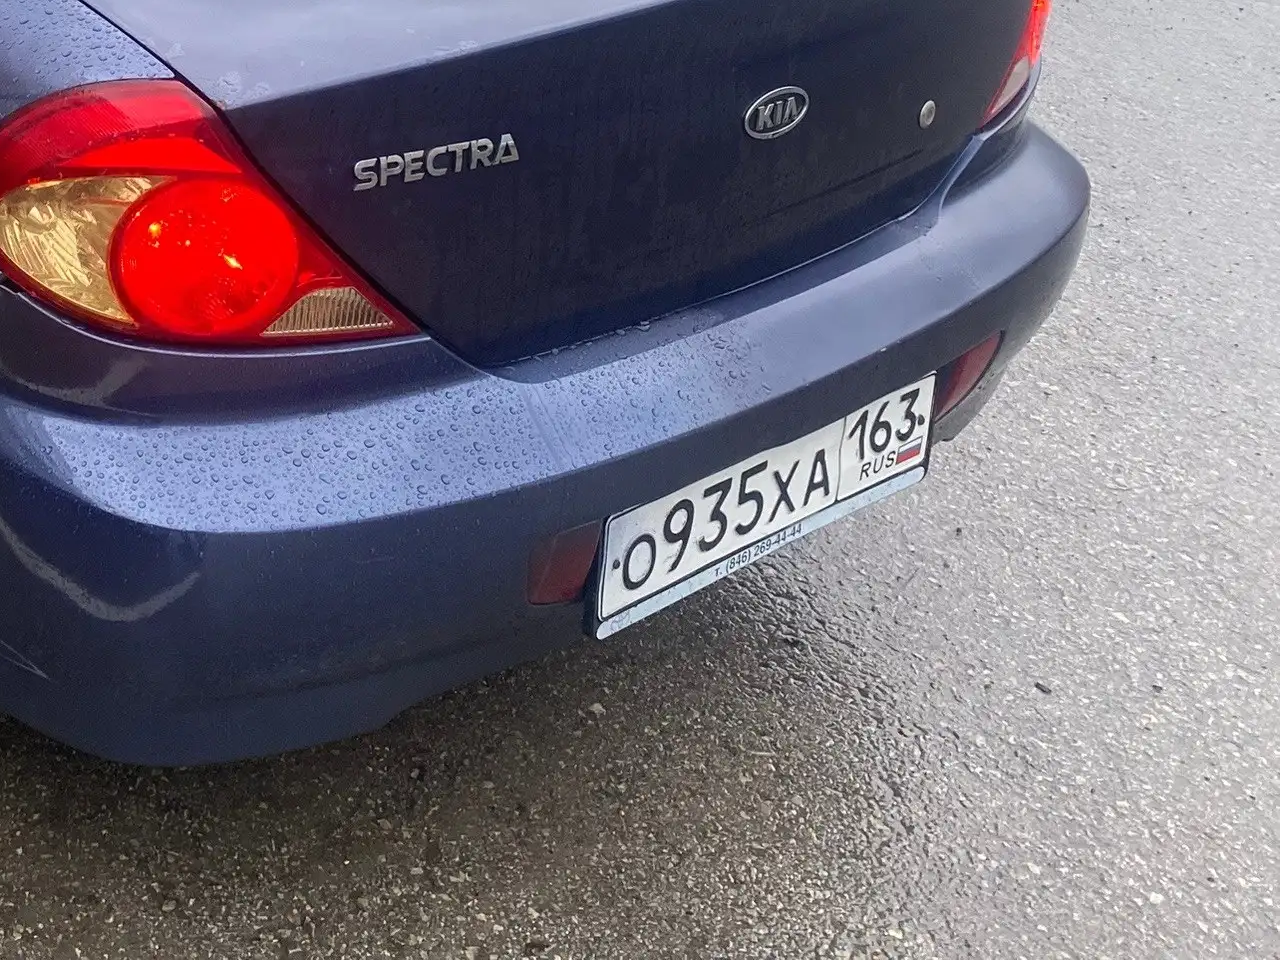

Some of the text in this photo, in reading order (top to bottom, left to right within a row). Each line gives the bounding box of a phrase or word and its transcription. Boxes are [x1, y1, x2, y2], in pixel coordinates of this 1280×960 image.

[755, 95, 800, 132] KIA
[352, 132, 521, 192] SPECTRA
[621, 387, 922, 591] О935ХА 163
[859, 450, 897, 482] RUS
[725, 548, 752, 574] (846)
[753, 523, 802, 558] 269-44-44
